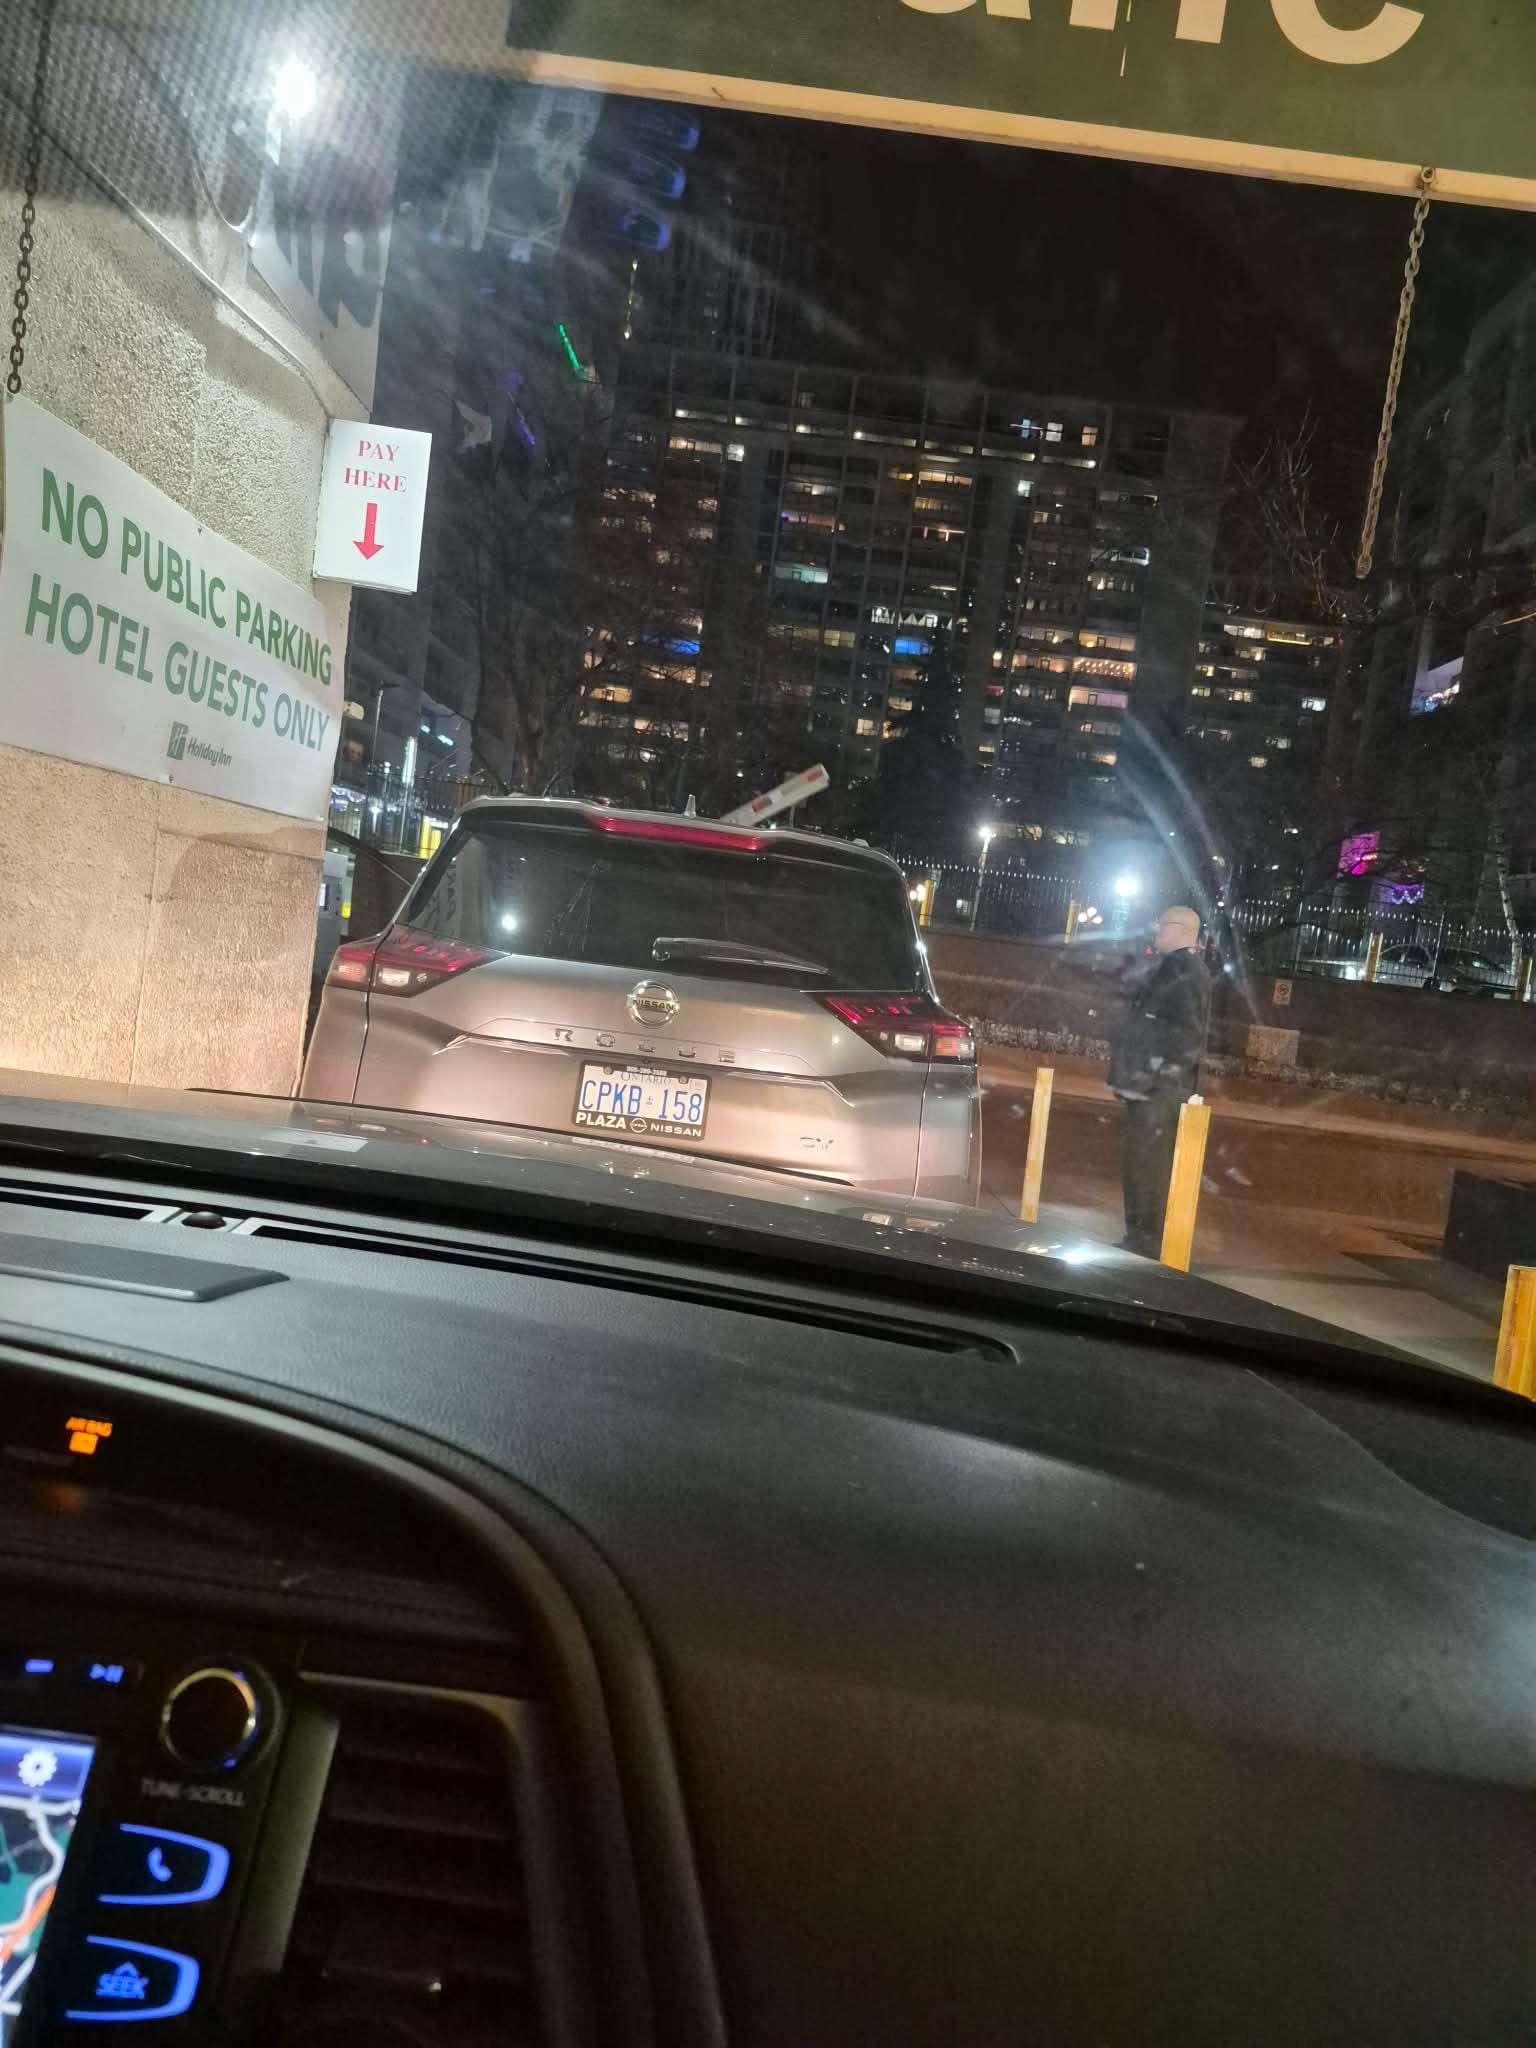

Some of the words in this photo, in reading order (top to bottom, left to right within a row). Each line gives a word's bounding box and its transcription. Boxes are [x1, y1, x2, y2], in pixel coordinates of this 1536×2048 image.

[358, 440, 400, 461] PAY
[344, 467, 407, 492] HERE
[42, 467, 108, 559] NO
[121, 517, 226, 628] PUBLIC
[236, 590, 332, 686] PARKING
[25, 573, 153, 683] HOTEL
[165, 641, 268, 728] GUESTS
[273, 693, 330, 751] ONLY
[187, 736, 219, 767] Holiday
[219, 747, 232, 766] Inn
[632, 999, 674, 1010] NISSAN
[582, 1080, 641, 1115] CPKB
[658, 1089, 702, 1122] 158
[576, 1111, 626, 1130] PLAZA
[650, 1122, 702, 1137] NISSAN
